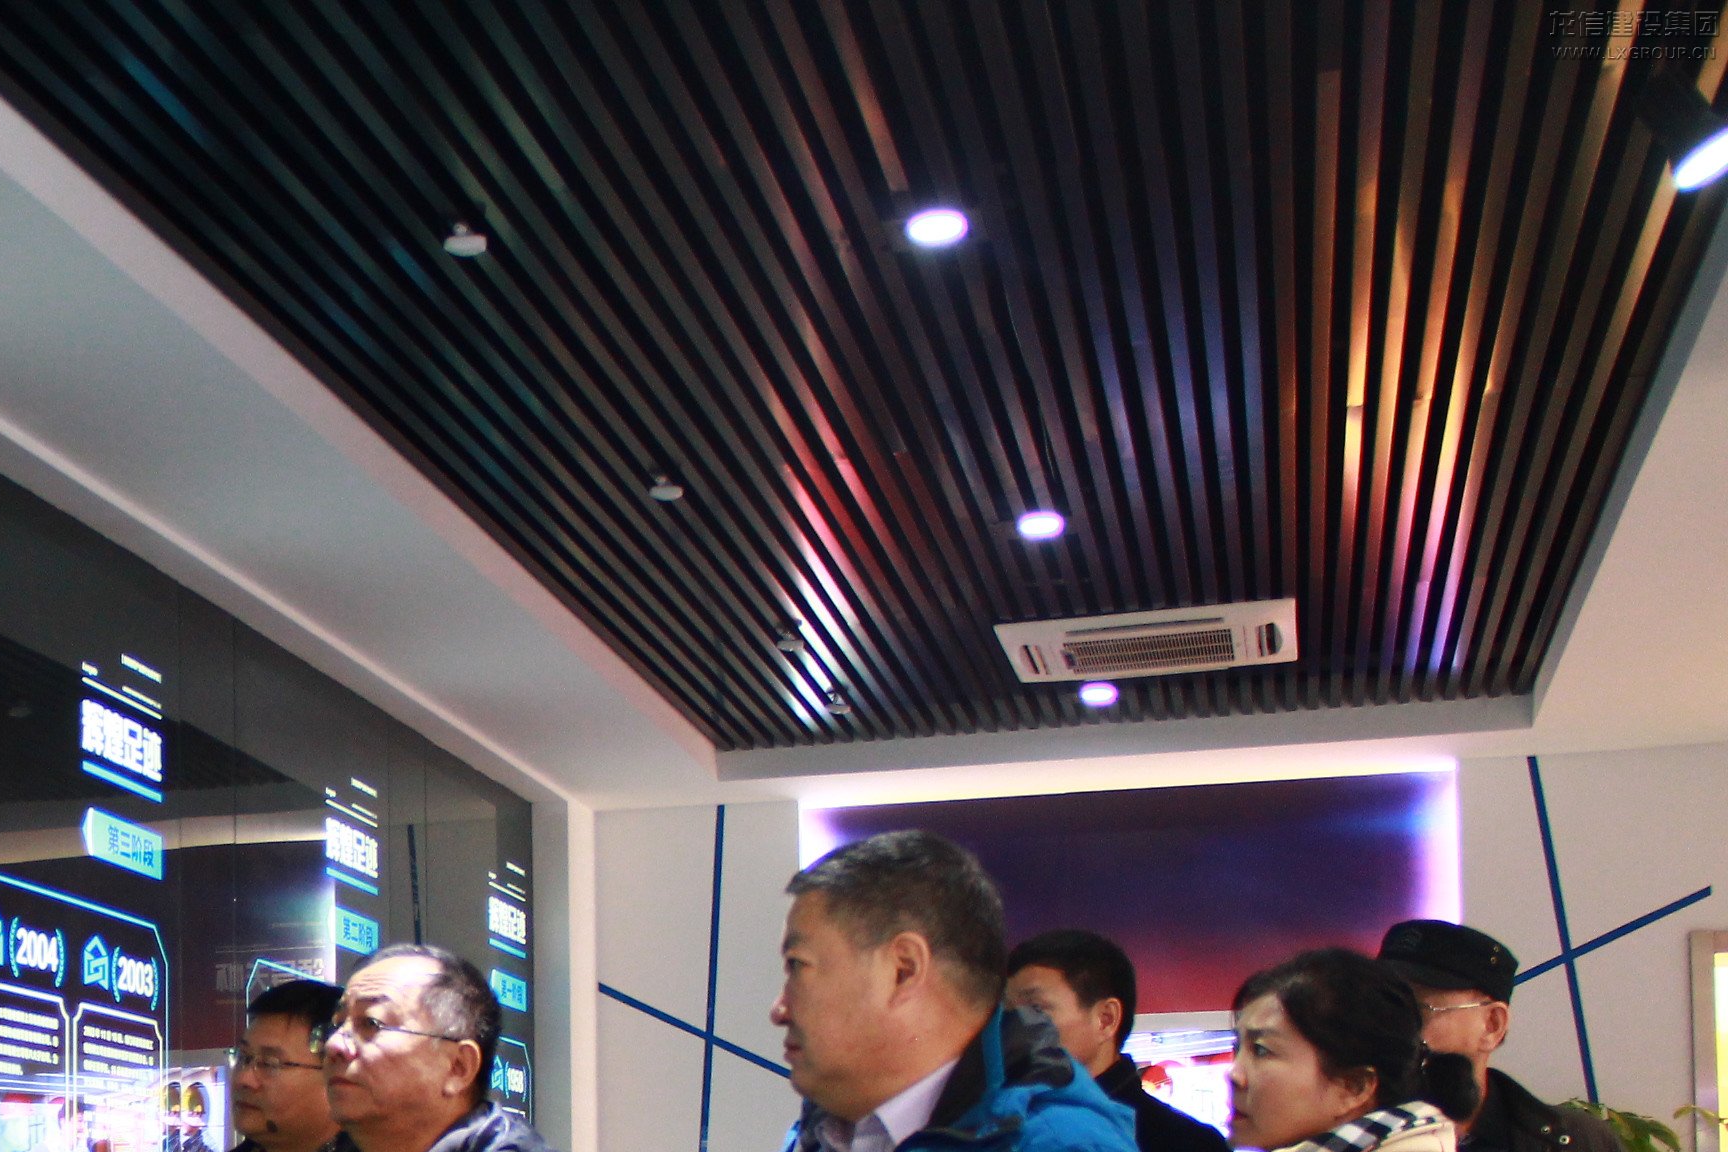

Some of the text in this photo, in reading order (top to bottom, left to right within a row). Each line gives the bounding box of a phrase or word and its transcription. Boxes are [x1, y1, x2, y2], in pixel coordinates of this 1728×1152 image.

[81, 698, 163, 783] 辉煌足迹
[107, 824, 155, 868] 第三阶段
[15, 927, 59, 974] 2004
[117, 955, 155, 998] 2003
